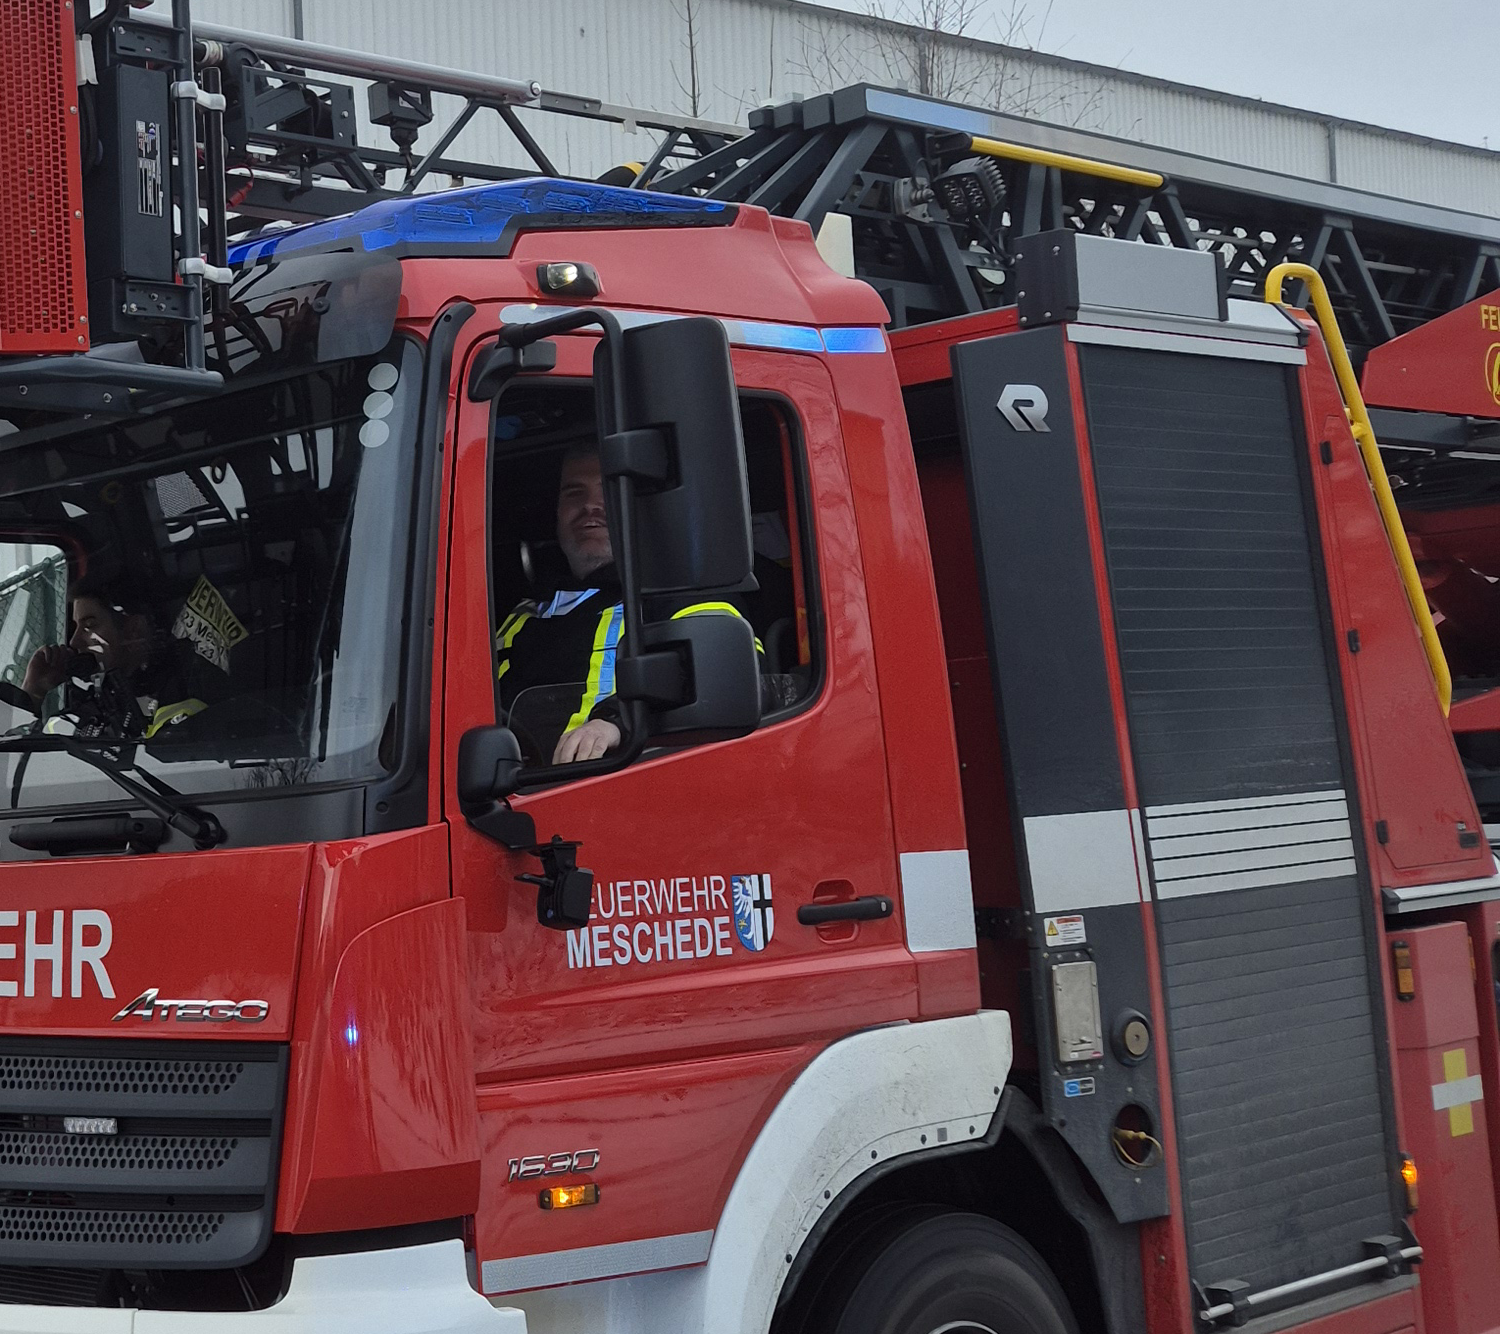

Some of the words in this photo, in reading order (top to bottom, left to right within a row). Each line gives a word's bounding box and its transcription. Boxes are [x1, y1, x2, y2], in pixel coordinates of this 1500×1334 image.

[1480, 304, 1500, 332] FE
[589, 875, 728, 920] UERWEHR
[566, 916, 733, 969] MESCHEDE
[507, 1148, 600, 1183] 1630
